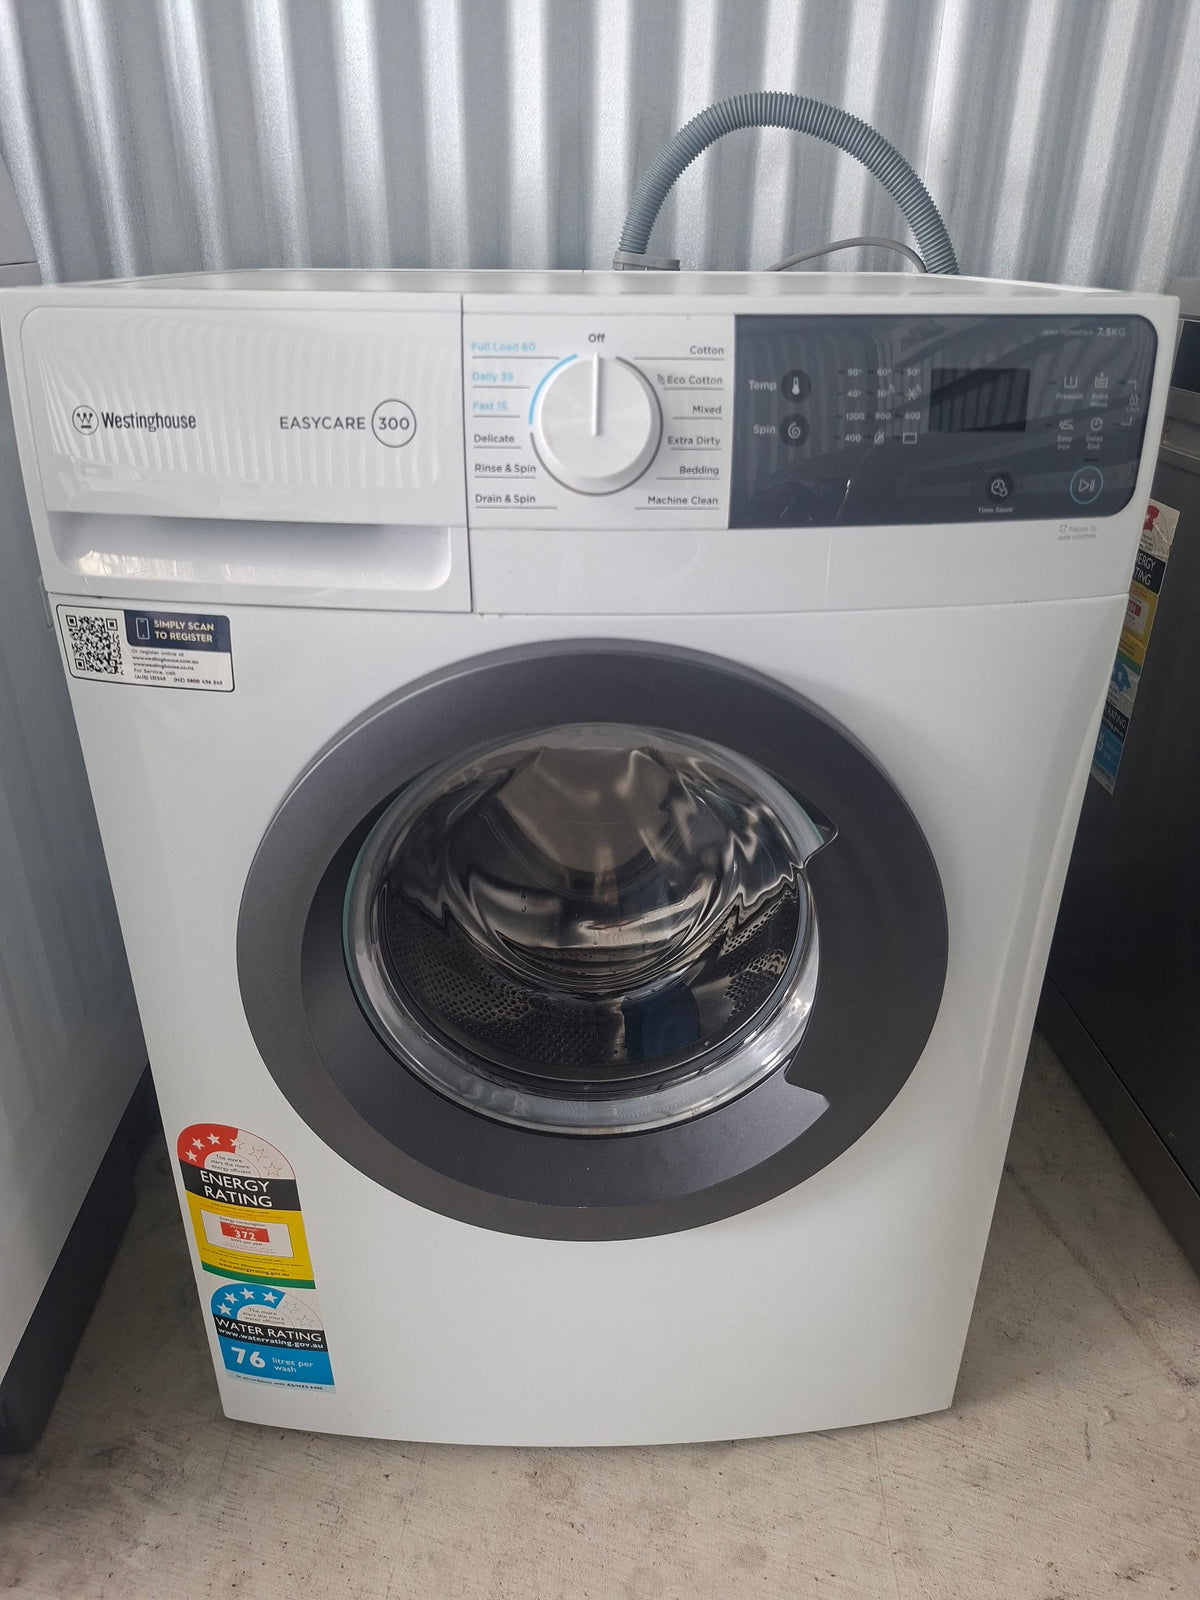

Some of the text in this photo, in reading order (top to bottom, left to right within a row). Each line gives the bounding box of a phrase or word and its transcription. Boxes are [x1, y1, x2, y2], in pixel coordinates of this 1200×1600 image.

[588, 333, 605, 343] Off
[471, 341, 490, 352] Full
[493, 341, 519, 352] Load
[689, 345, 724, 355] Cotton
[471, 371, 498, 383] Daily
[667, 375, 723, 385] Eco Cotton
[748, 379, 777, 392] Temp
[472, 400, 508, 411] Fast 15
[692, 405, 722, 414] Mixed
[101, 411, 197, 432] Westinghouse
[279, 416, 410, 431] EASYCARE 300
[753, 424, 776, 435] Spin
[473, 434, 515, 444] Delicate
[667, 435, 721, 447] Extra Dirty
[844, 433, 861, 442] 400
[474, 463, 537, 475] Rinse & Spin
[679, 466, 719, 477] Bedding
[475, 494, 536, 505] Drain & Spin
[647, 496, 719, 505] Machine Clean
[154, 619, 214, 631] SIMPLY SCAN
[155, 631, 213, 643] TO REGISTER
[200, 1170, 270, 1193] ENERGY
[204, 1186, 273, 1208] RATING
[219, 1216, 236, 1224] Energy
[234, 1229, 256, 1241] 372
[215, 1316, 322, 1342] WATER RATING
[217, 1328, 324, 1349] www.waterrating.gov.au
[231, 1346, 266, 1369] 76
[272, 1357, 314, 1370] litres per
[273, 1365, 297, 1373] wash
